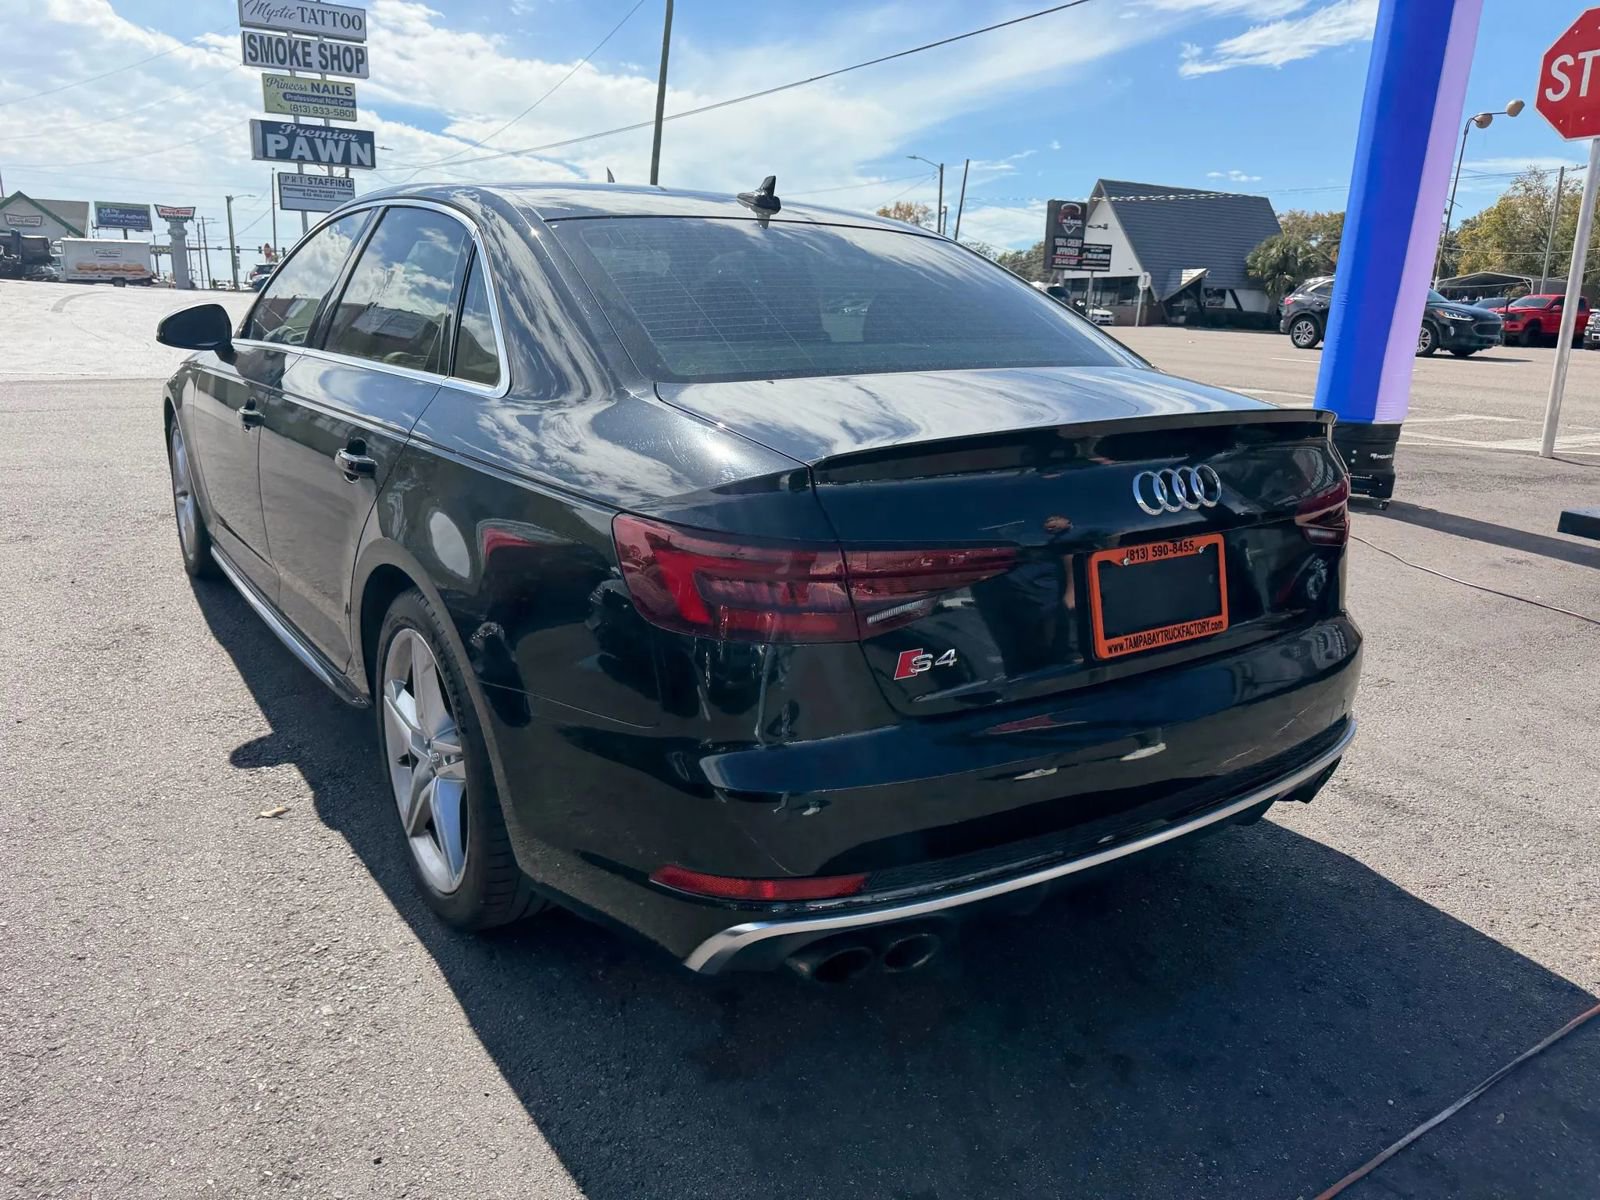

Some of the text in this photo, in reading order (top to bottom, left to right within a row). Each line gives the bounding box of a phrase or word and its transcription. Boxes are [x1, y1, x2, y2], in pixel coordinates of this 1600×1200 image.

[243, 0, 362, 31] Mystic TATTOO
[246, 33, 365, 74] SMOKE SHOP
[1545, 48, 1600, 103] ST
[310, 82, 353, 97] NAILS
[289, 103, 310, 114] (813)
[278, 123, 359, 142] Premier
[265, 132, 371, 167] PAWN
[307, 176, 352, 188] STAFFING
[1126, 540, 1194, 561] (813) 590-8455
[1107, 619, 1224, 655] www.TAMPABAYTRUCKFACTORY.com
[910, 648, 958, 674] S4
